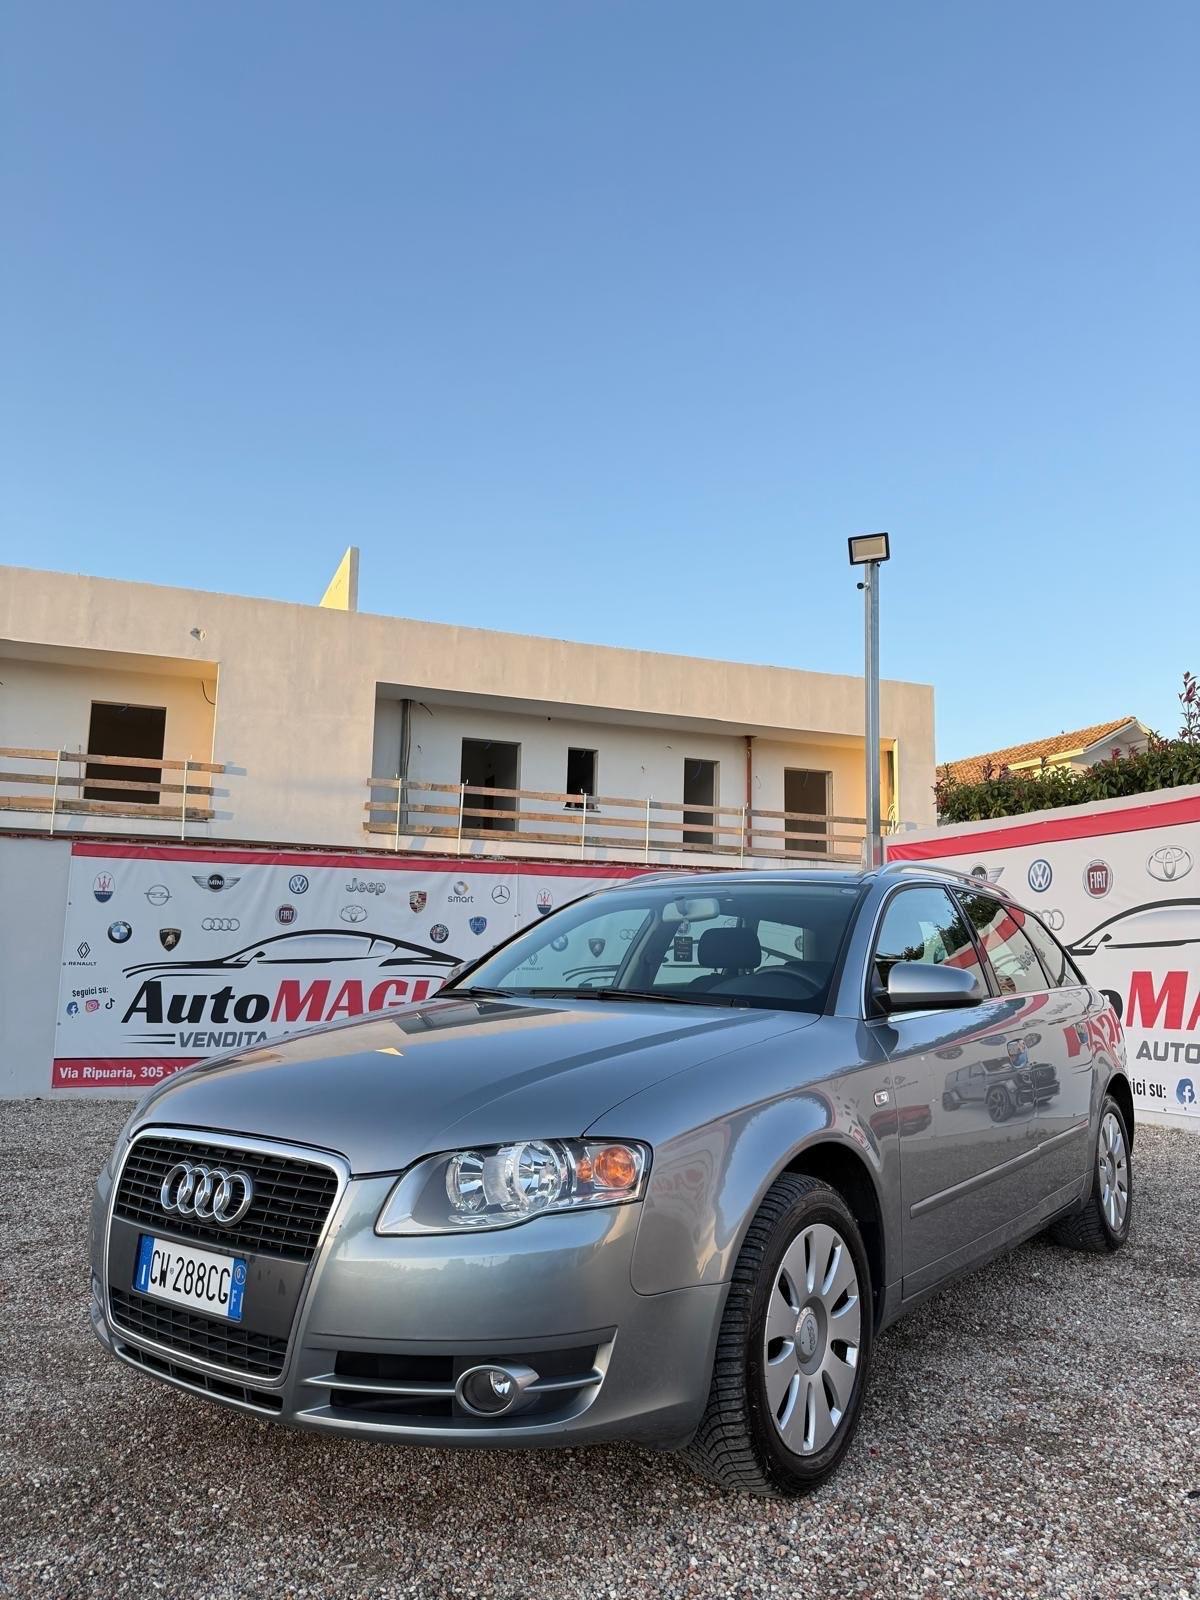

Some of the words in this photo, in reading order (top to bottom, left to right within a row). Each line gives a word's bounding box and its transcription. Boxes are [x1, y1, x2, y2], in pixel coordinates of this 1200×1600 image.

[345, 878, 386, 895] Jeep
[1089, 870, 1107, 889] FIAT
[447, 895, 474, 903] smart
[280, 910, 294, 921] FIAT
[72, 987, 97, 998] Seguici
[179, 1031, 268, 1048] VENDITA
[59, 1067, 79, 1078] Via
[82, 1066, 136, 1080] Ripuaria,
[140, 1066, 164, 1077] 305
[1149, 1083, 1167, 1099] su:
